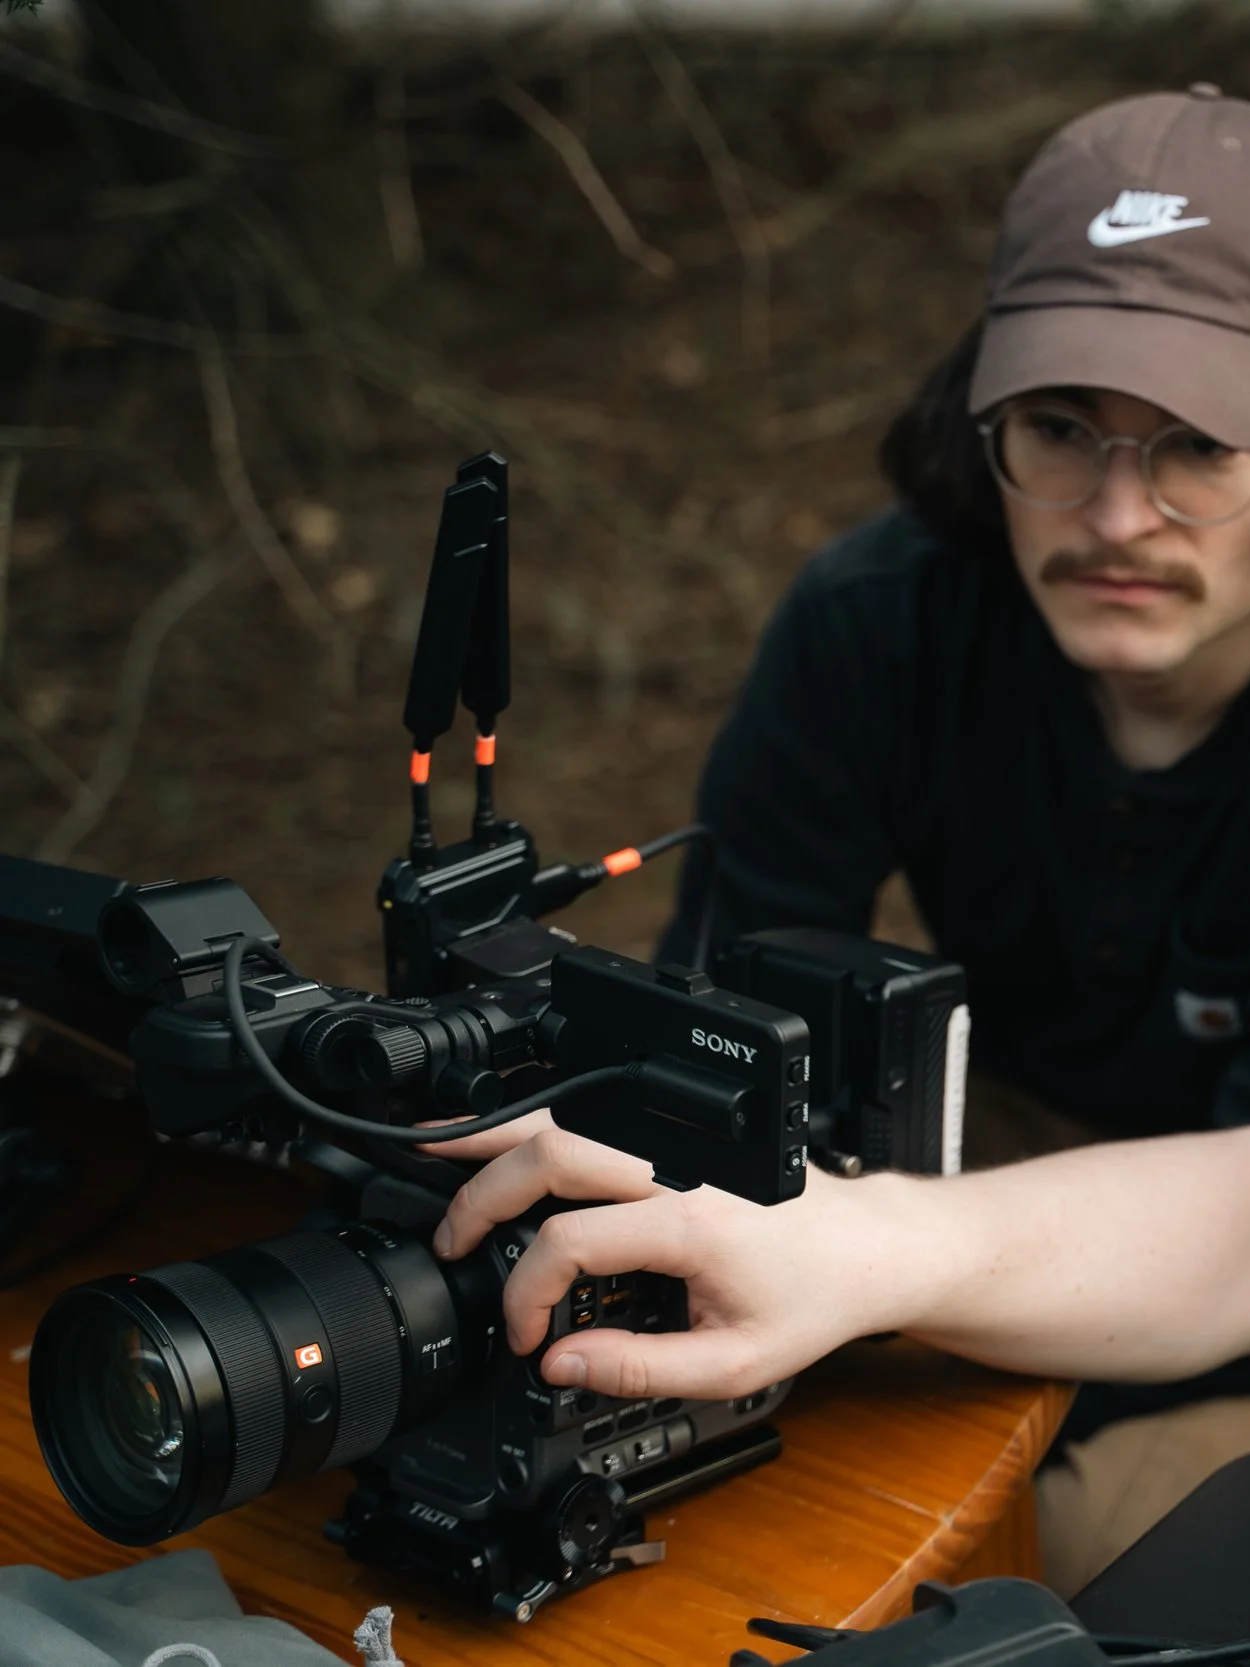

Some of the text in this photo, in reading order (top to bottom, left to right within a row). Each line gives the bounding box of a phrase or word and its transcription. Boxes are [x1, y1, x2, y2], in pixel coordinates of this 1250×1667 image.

[1108, 189, 1190, 227] NIKE
[691, 1028, 758, 1064] SONY
[299, 1347, 318, 1366] G
[421, 1343, 432, 1354] AF
[408, 1501, 461, 1531] TILTA
